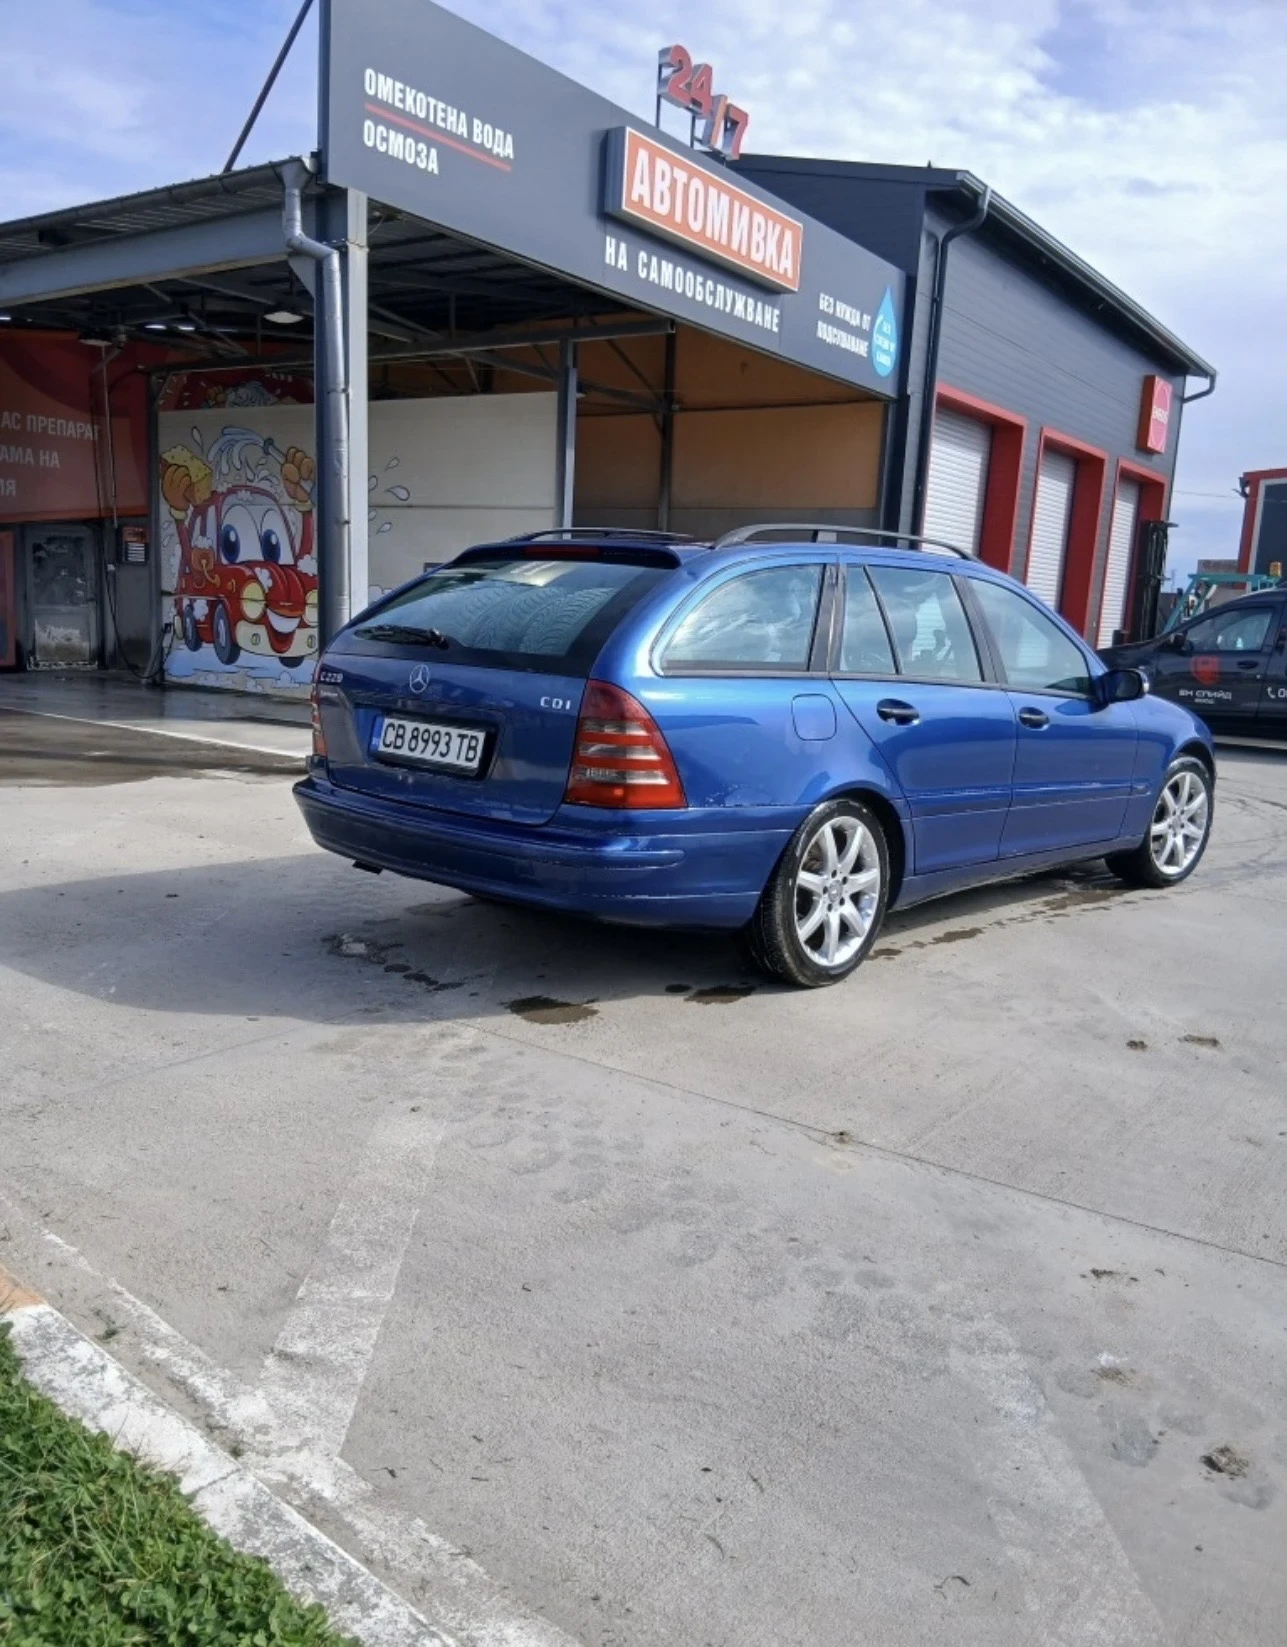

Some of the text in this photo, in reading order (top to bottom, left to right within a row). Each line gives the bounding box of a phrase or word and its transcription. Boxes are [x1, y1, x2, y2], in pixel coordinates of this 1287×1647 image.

[364, 68, 514, 159] ОМЕКОТЕНА ВОДА
[658, 44, 749, 161] 24/7
[363, 119, 439, 175] ОСМОЗА
[631, 148, 793, 278] АВТОМИВКА
[605, 236, 780, 333] НА САМООБСЛУЖВАНЕ
[39, 449, 61, 469] НА
[540, 696, 572, 710] CDI
[382, 722, 479, 763] CB 8993 TB
